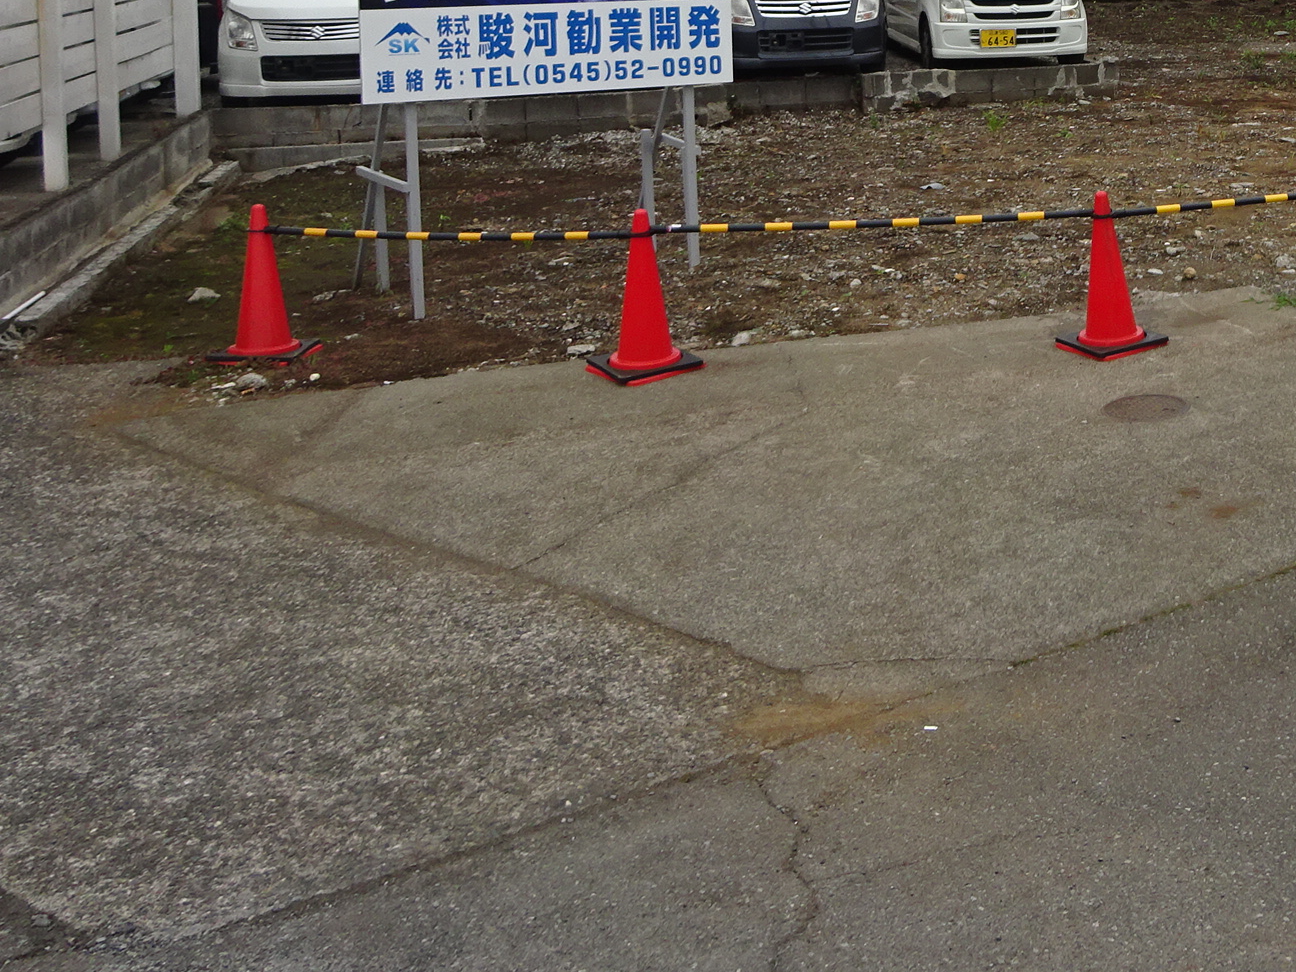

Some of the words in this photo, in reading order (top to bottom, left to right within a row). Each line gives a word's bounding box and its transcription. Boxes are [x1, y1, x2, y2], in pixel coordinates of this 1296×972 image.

[388, 38, 420, 54] SK
[478, 4, 722, 61] 駿河勧業開発
